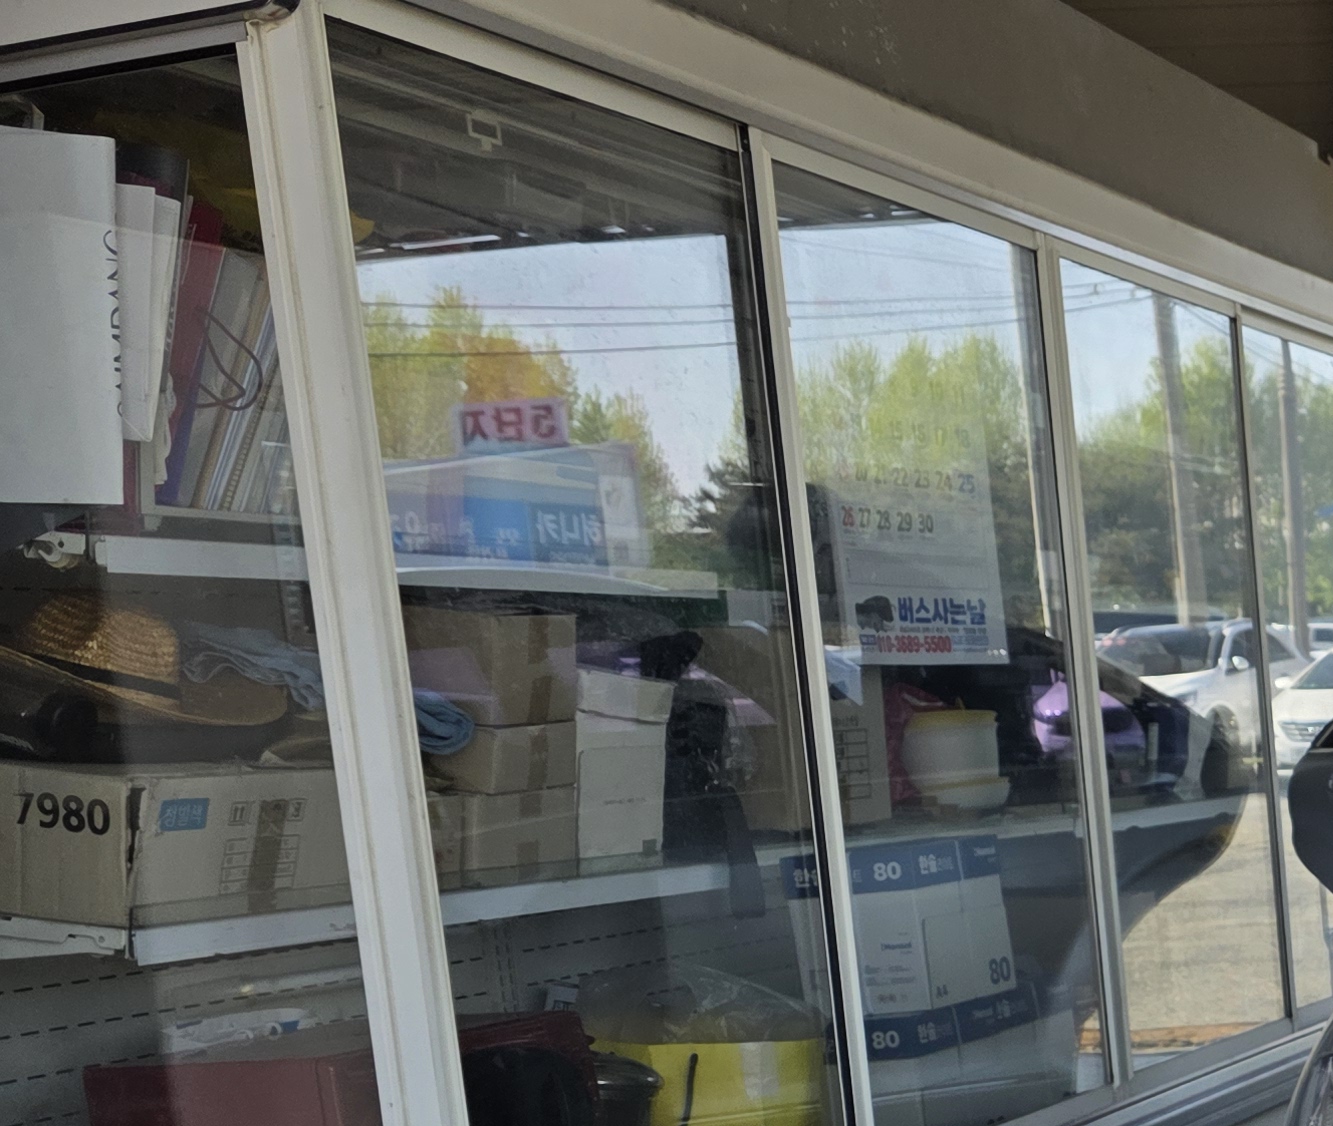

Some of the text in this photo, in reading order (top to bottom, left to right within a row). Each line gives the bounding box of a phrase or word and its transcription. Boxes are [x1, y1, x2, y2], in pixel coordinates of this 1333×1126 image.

[958, 473, 975, 494] 25
[858, 507, 871, 528] 27
[876, 509, 892, 530] 28
[897, 511, 912, 532] 29
[918, 513, 934, 534] 30
[14, 791, 110, 835] 7980
[793, 868, 819, 888] 한
[873, 861, 902, 882] 80
[989, 956, 1011, 985] 80
[872, 1030, 900, 1050] 80
